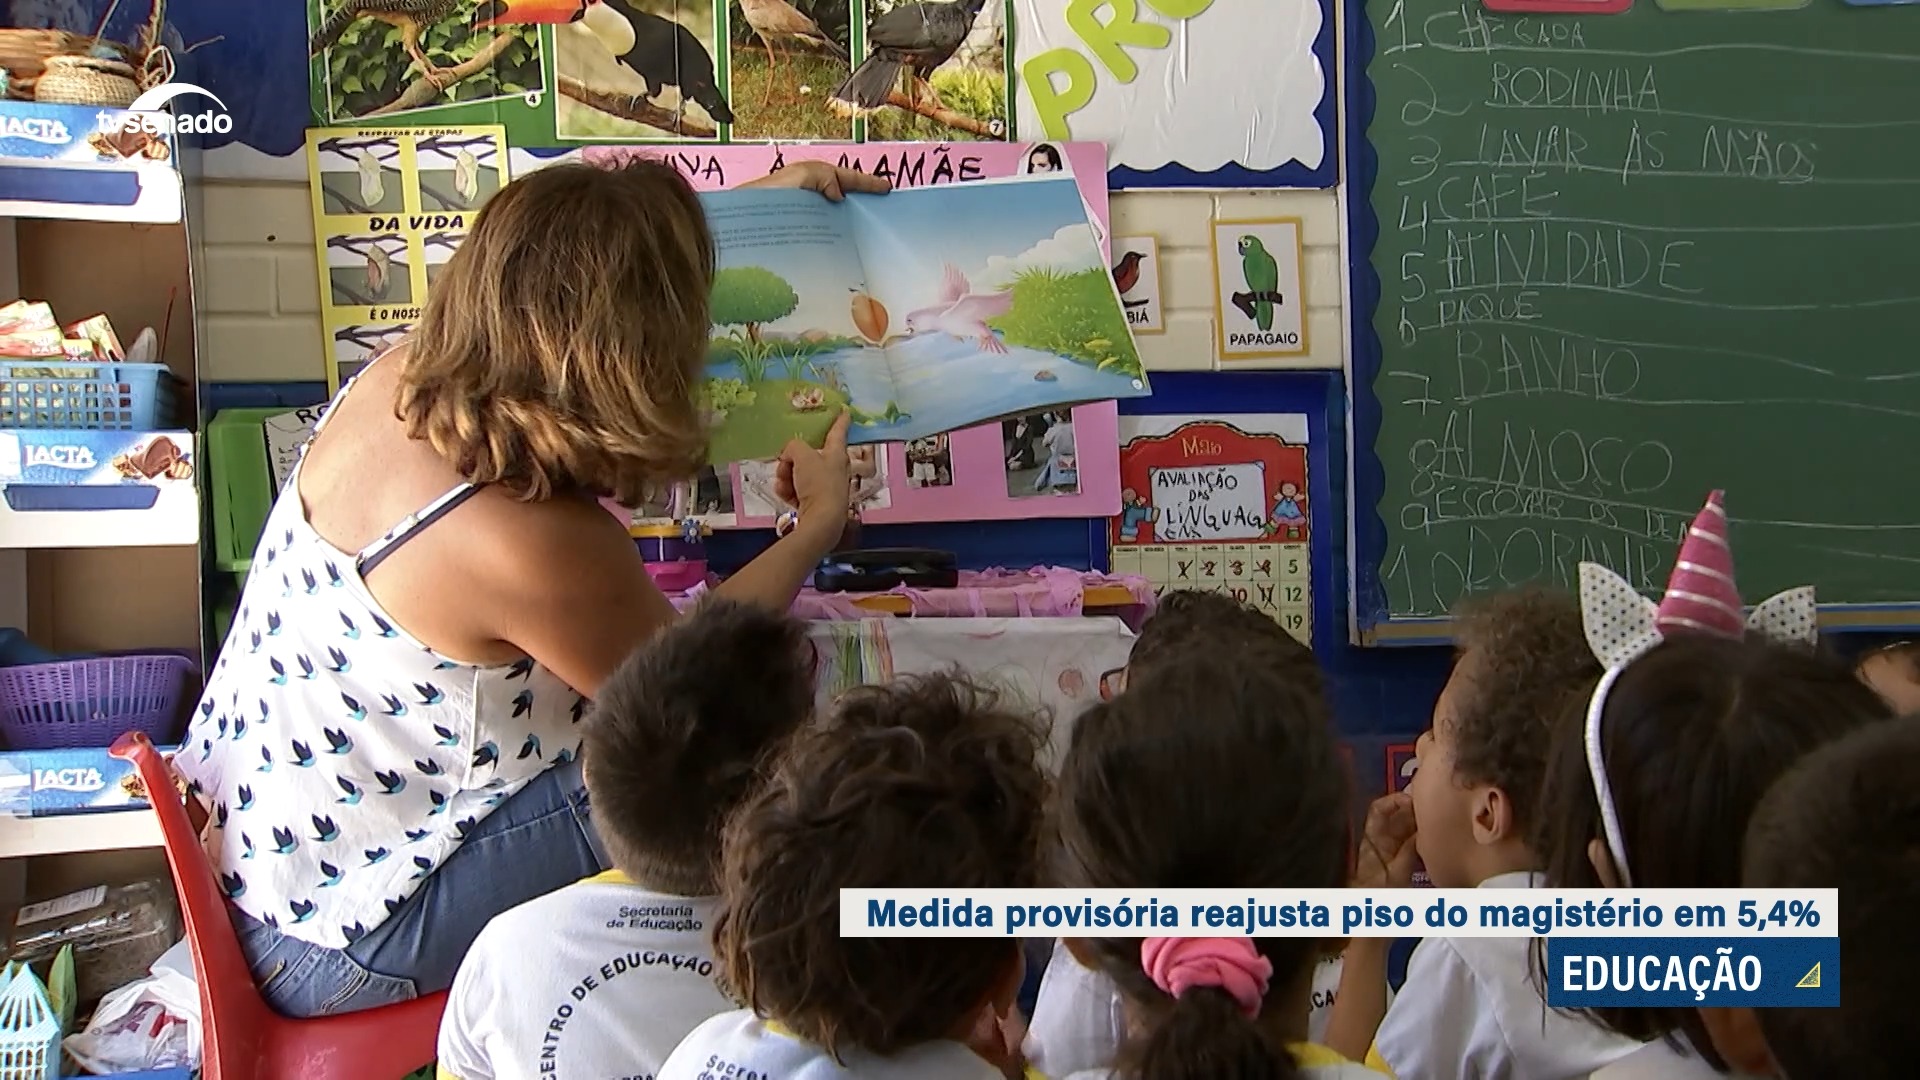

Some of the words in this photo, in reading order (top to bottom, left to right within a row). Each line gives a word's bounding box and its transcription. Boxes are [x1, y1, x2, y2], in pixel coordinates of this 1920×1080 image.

[1385, 0, 1423, 56] 1
[1022, 0, 1214, 141] PR
[529, 94, 536, 103] 4
[1393, 64, 1472, 126] 2
[1491, 62, 1660, 118] RODINHA
[993, 123, 1000, 133] 7
[1397, 135, 1442, 186] 3
[369, 217, 400, 231] DA
[409, 215, 464, 230] VIDA
[1399, 195, 1429, 246] 4
[1401, 252, 1426, 302] 5
[380, 309, 388, 319] O
[1230, 332, 1299, 346] PAPAGAIO
[1388, 370, 1442, 416] 7
[1454, 329, 1640, 404] BANHO
[25, 445, 97, 470] LACTA
[1409, 439, 1439, 497] 8
[1158, 467, 1238, 492] AVALIAÇÃO
[1189, 489, 1210, 502] DAS
[1288, 559, 1298, 574] 5
[1285, 587, 1302, 602] 12
[1286, 615, 1303, 630] 19
[33, 768, 105, 792] LACTA
[619, 905, 693, 918] Secretaria
[629, 919, 703, 932] Educação
[571, 975, 599, 1001] DE
